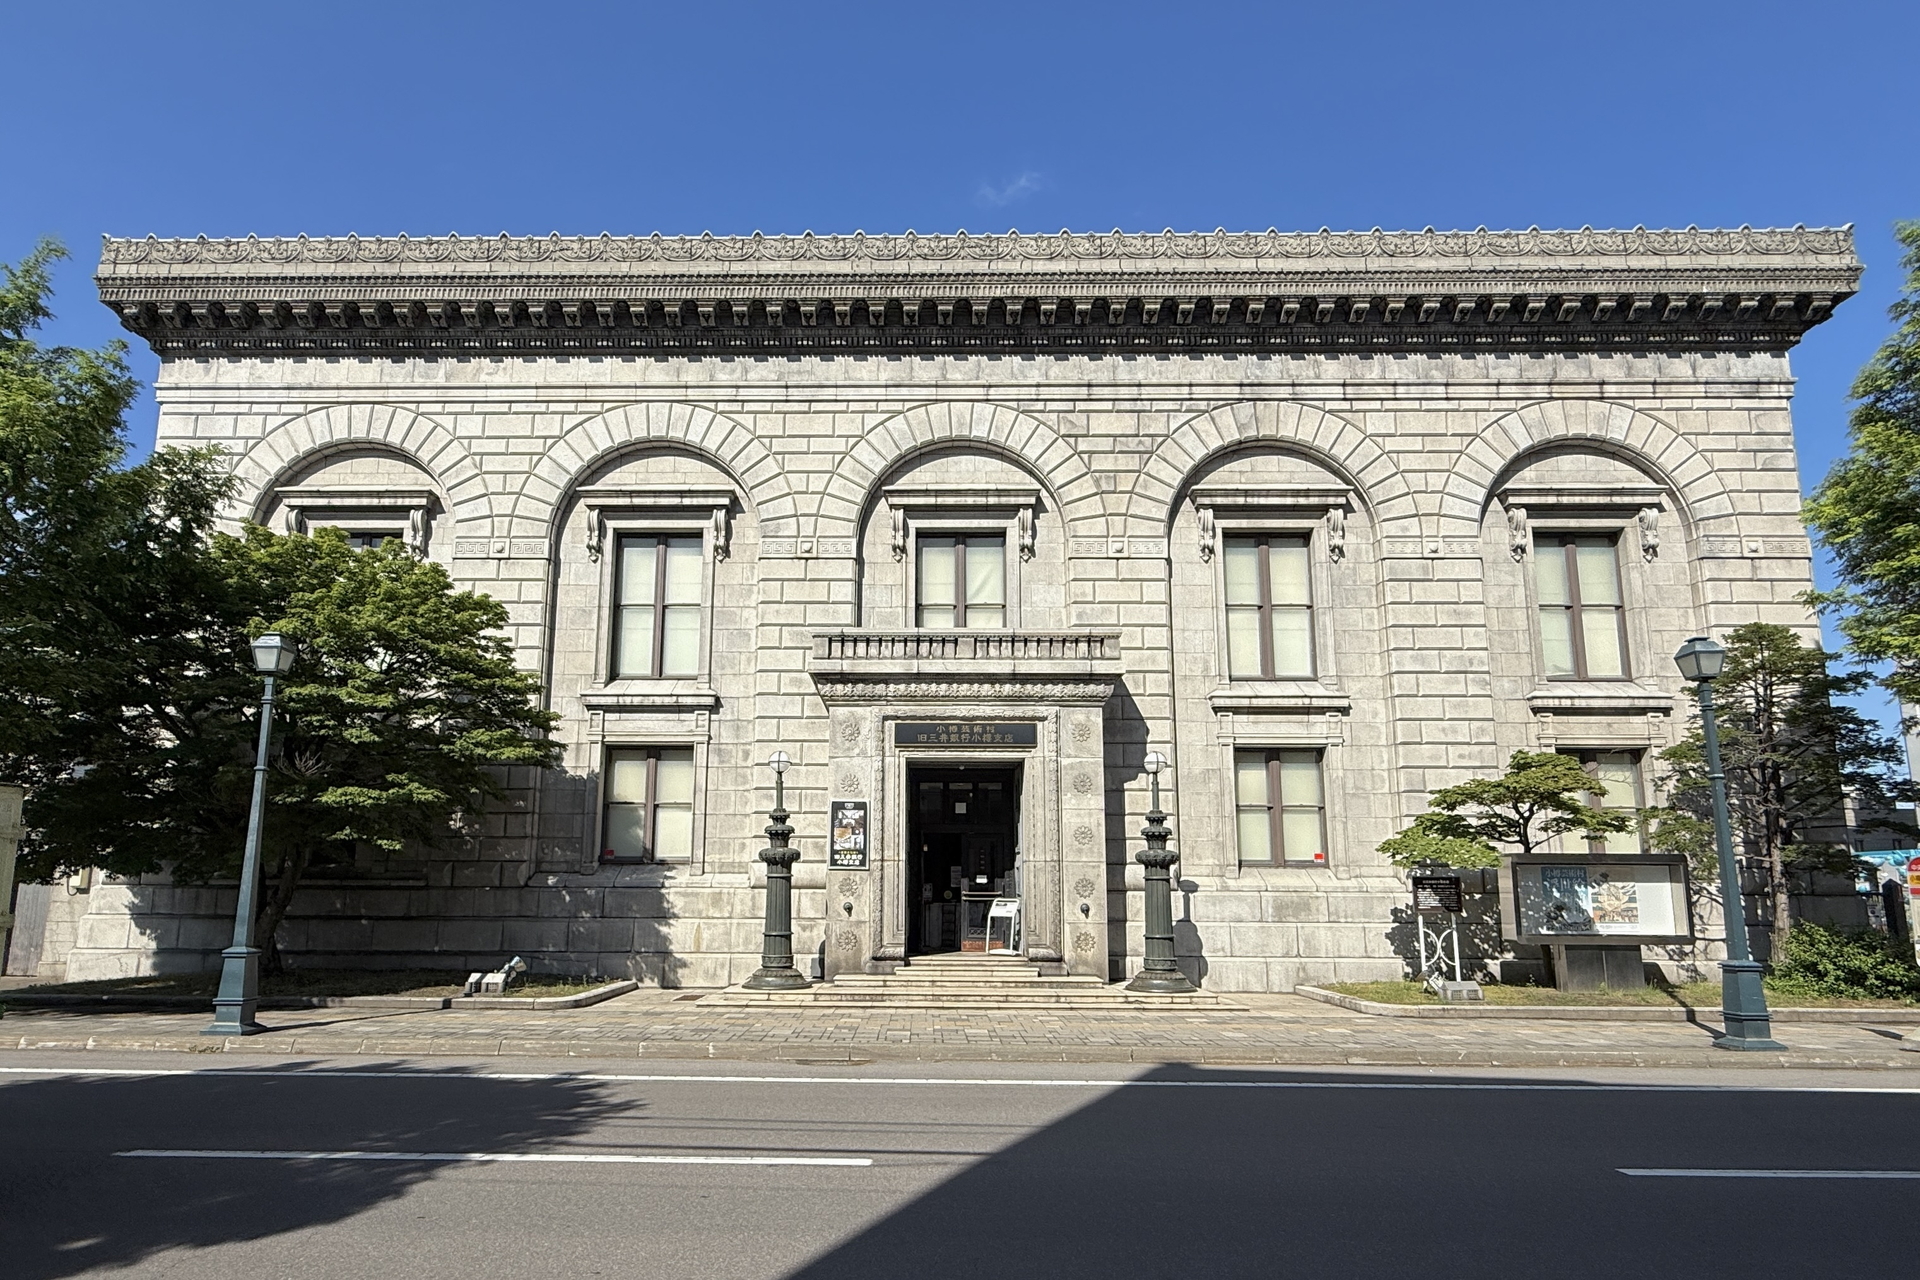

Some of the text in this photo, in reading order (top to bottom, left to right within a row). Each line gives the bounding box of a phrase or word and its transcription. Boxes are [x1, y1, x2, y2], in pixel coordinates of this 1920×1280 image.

[936, 725, 995, 733] 小樽芸術村
[917, 733, 1013, 743] 旧三井銀行小樽支店
